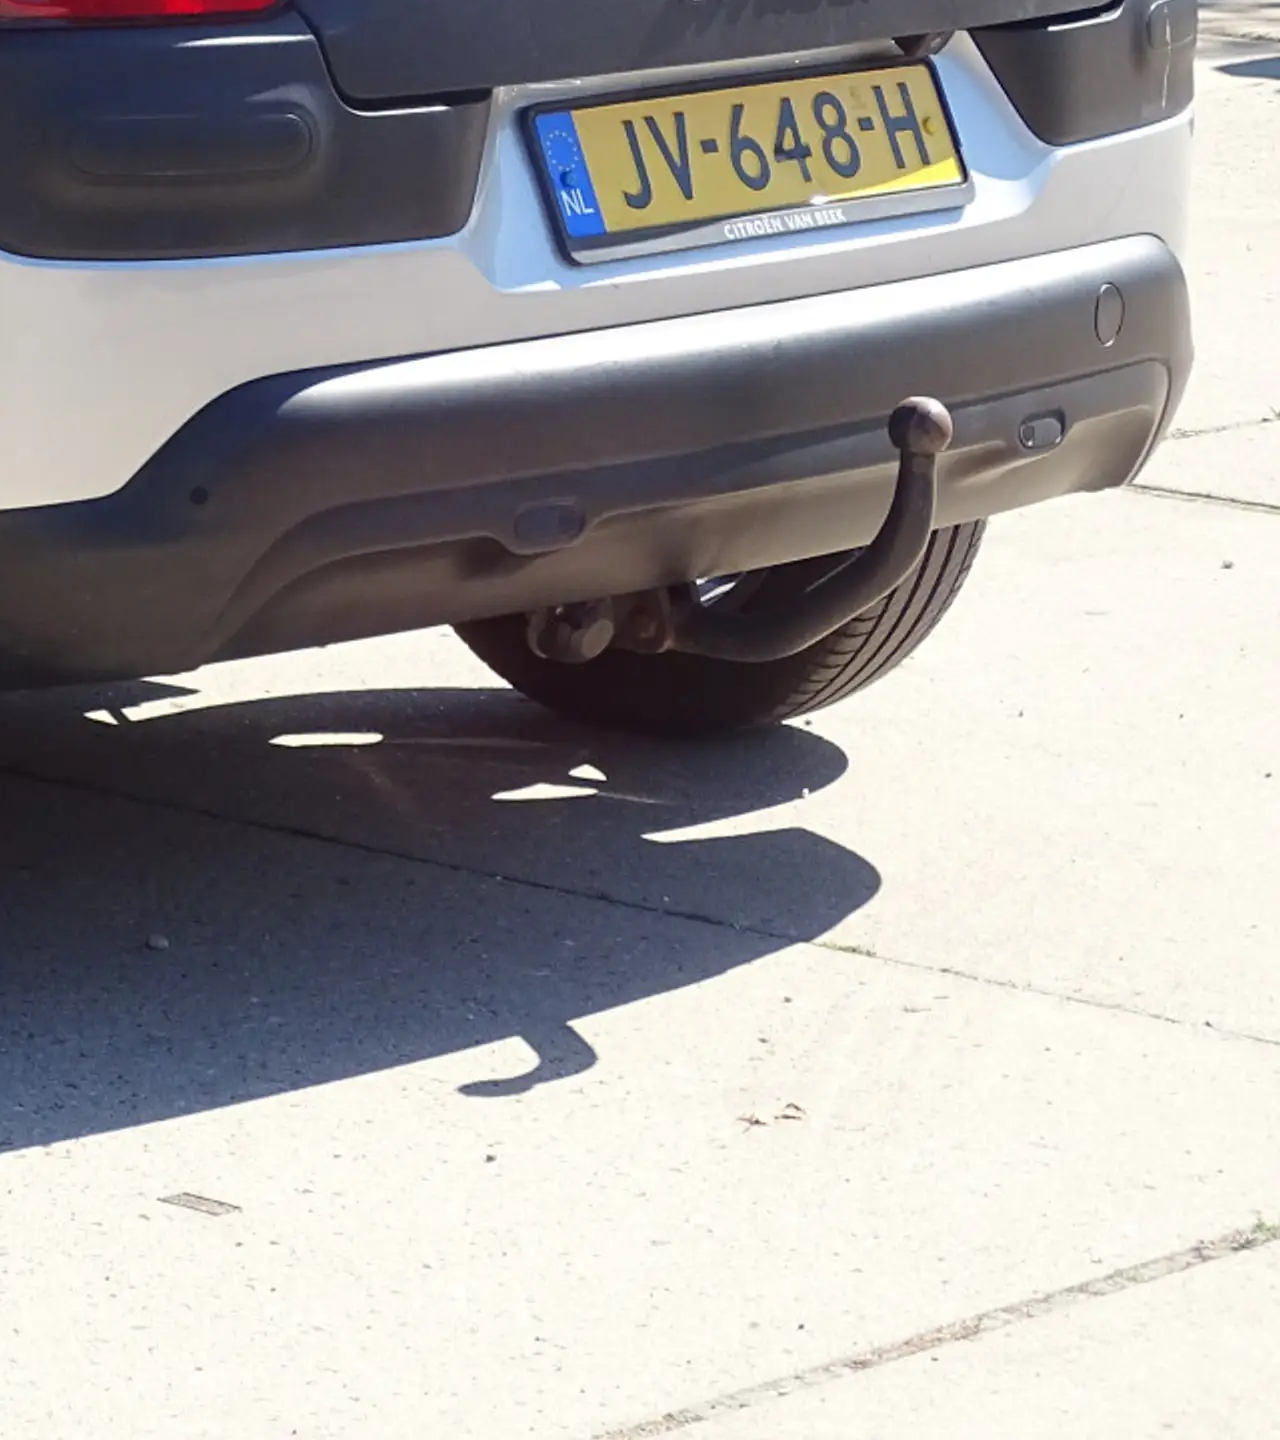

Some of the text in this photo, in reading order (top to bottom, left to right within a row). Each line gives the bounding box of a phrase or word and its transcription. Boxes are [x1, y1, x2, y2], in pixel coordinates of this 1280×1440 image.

[622, 81, 931, 210] JV-648-H
[560, 188, 596, 217] NL
[723, 208, 848, 240] CITROËN VAN BEEK
